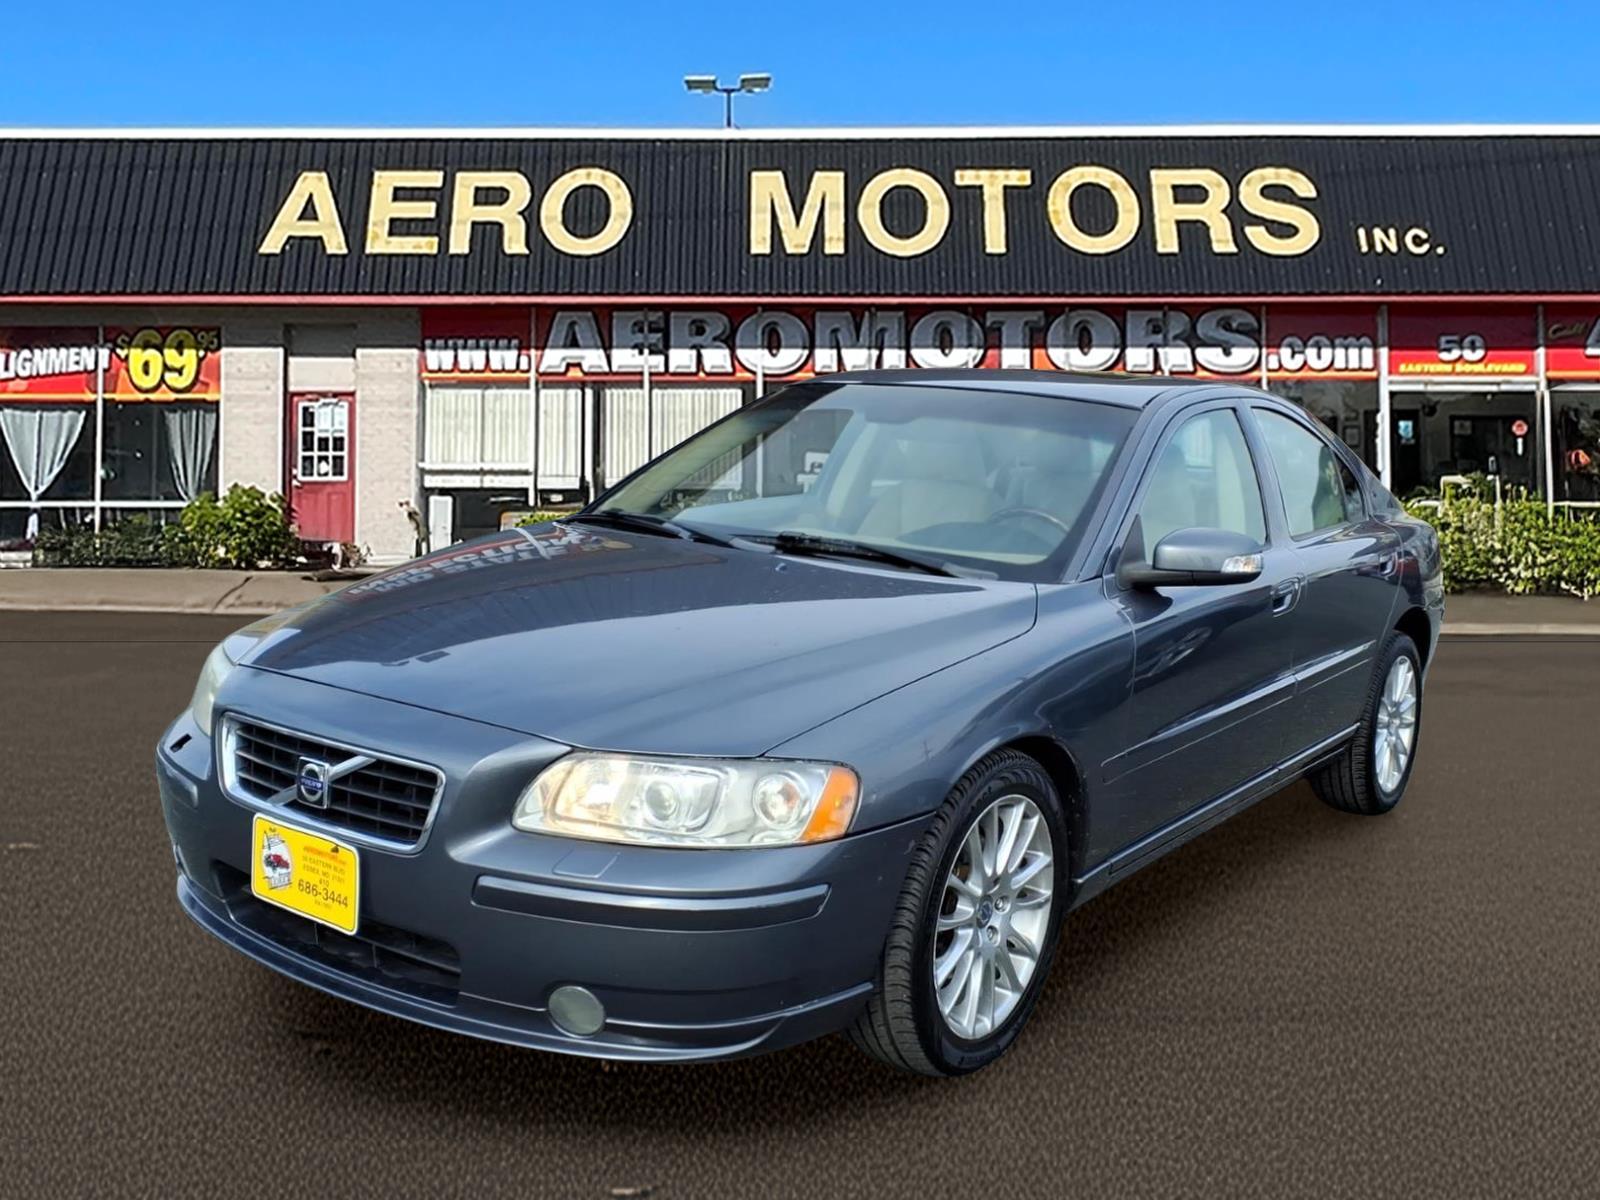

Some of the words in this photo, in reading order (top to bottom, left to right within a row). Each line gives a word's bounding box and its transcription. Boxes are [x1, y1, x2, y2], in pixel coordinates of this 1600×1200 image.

[258, 167, 634, 256] AERO
[749, 165, 1321, 257] MOTORS
[1356, 226, 1445, 255] INC.
[1437, 334, 1486, 362] 50
[297, 878, 348, 908] 686-3444
